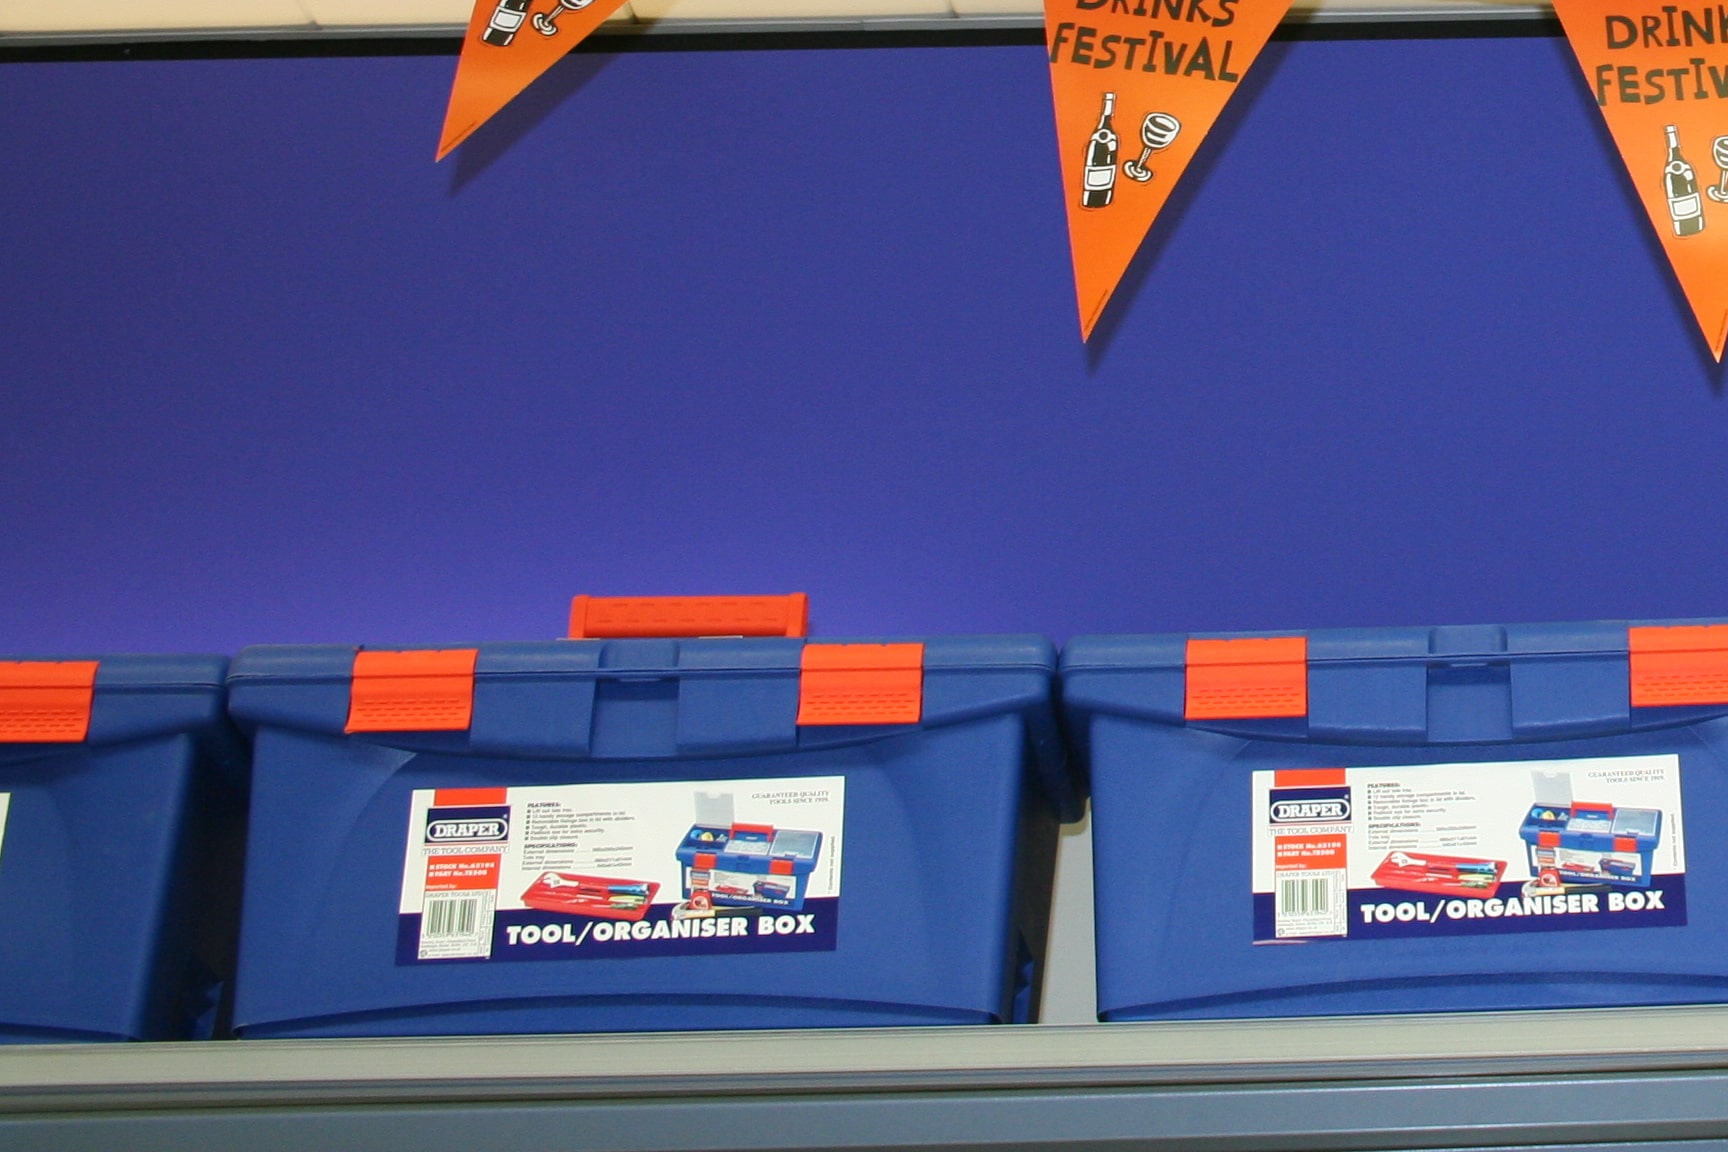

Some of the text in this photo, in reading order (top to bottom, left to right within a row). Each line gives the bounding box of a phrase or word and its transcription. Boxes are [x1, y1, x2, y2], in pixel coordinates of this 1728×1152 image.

[1049, 21, 1239, 84] FESTIVAL
[1278, 802, 1343, 818] DRAPER
[433, 822, 500, 839] DRAPER
[1359, 889, 1666, 924] TOOL/ORGANISER BOX
[506, 916, 749, 947] TOOL/ORGANISER
[756, 912, 816, 937] BOX
